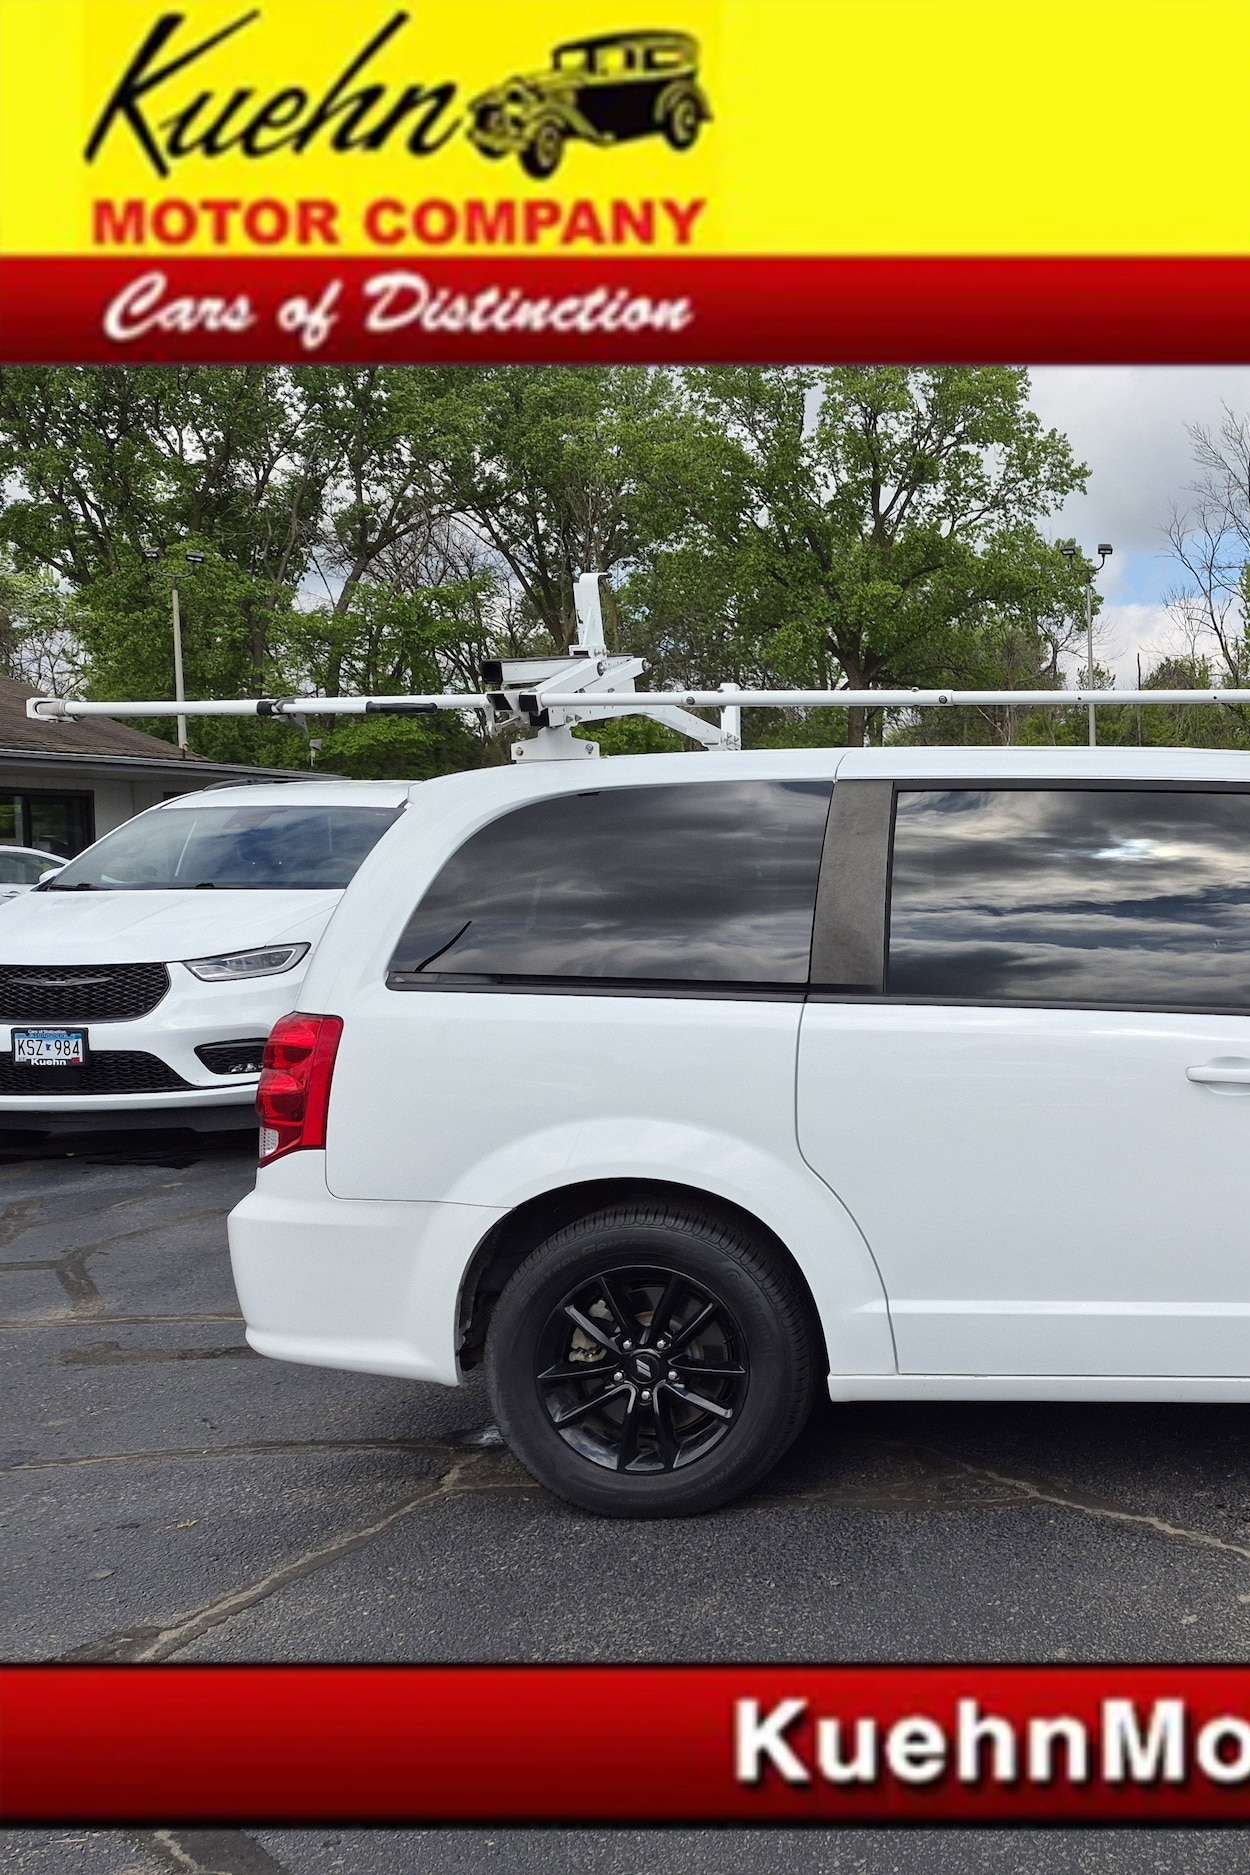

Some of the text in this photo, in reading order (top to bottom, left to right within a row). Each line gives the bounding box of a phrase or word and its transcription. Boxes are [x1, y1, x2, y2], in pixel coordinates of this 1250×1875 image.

[17, 1039, 80, 1056] KSZ 984
[31, 1058, 67, 1066] Kuehn
